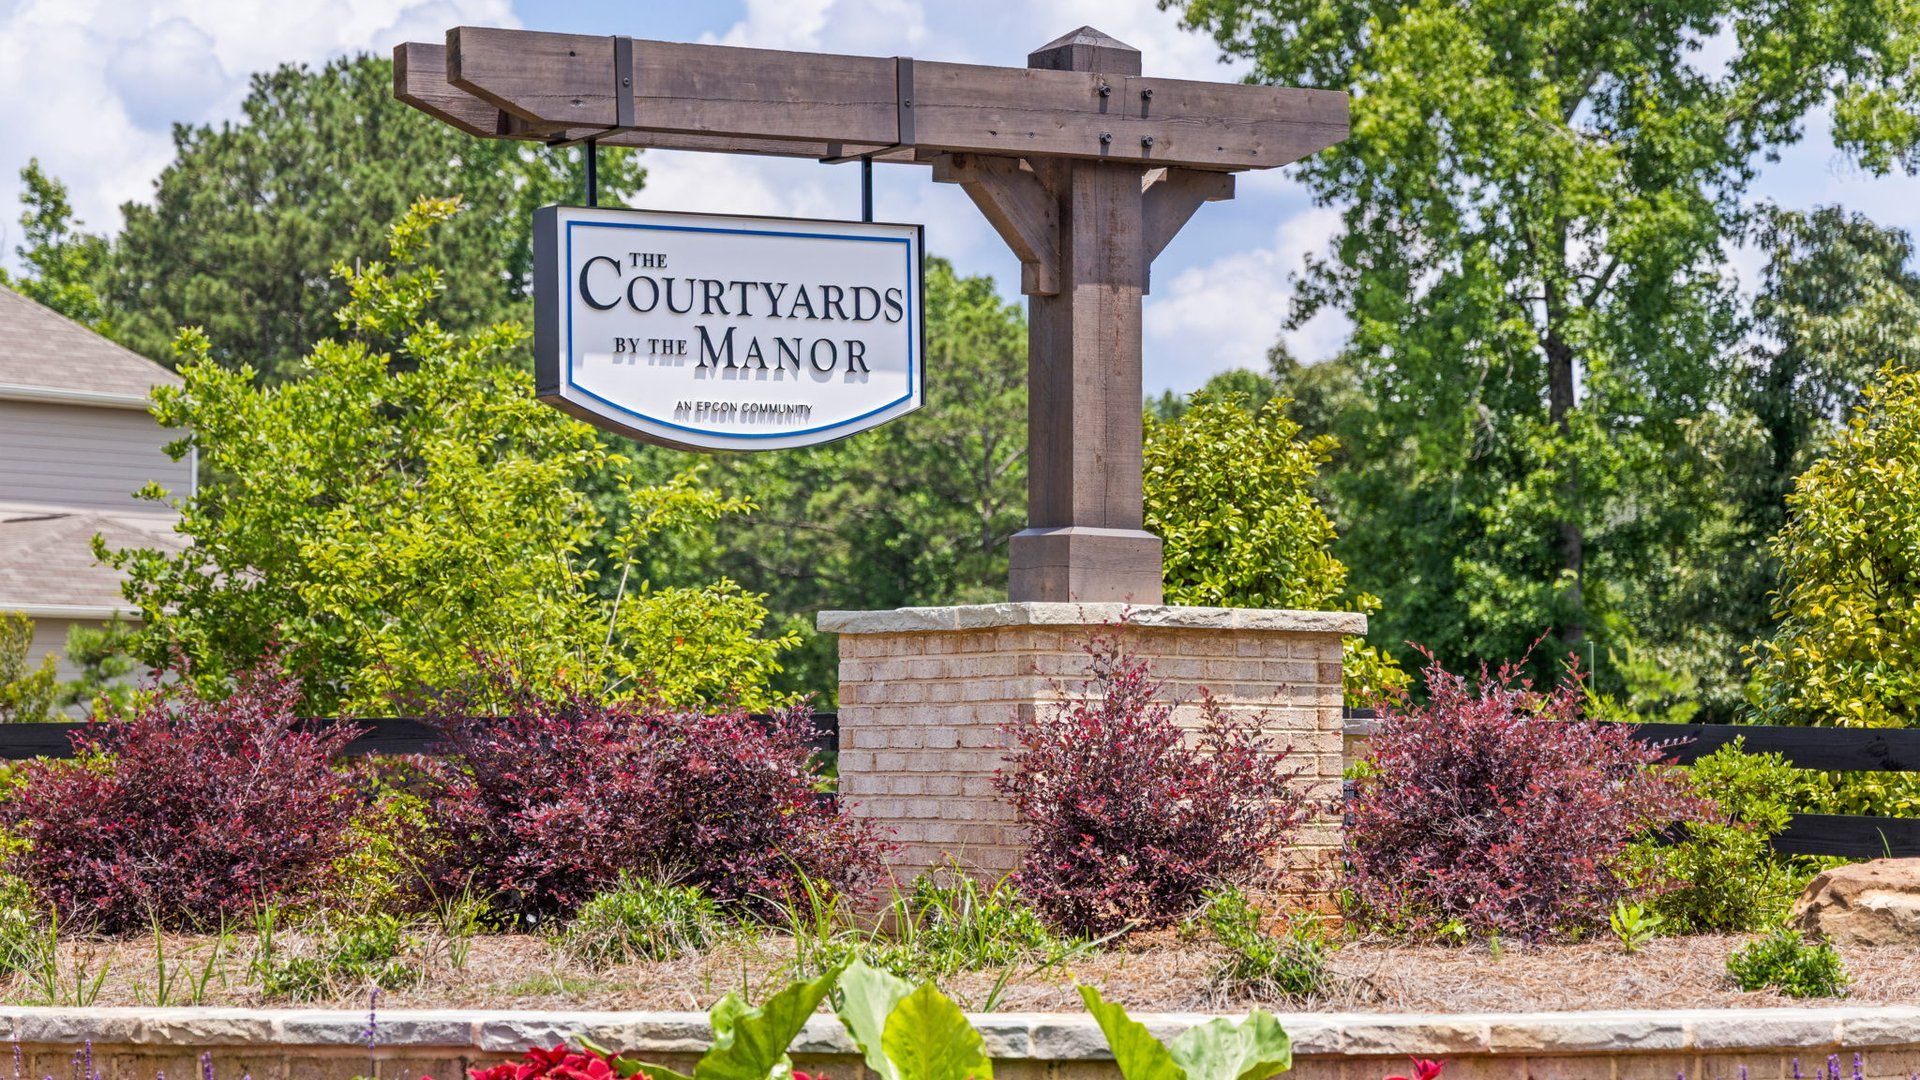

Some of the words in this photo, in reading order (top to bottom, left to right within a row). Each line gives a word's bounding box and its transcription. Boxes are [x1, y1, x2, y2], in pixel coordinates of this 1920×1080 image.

[629, 252, 667, 269] THE
[579, 256, 903, 323] COURTYARDS
[614, 337, 640, 353] BY
[648, 338, 687, 355] THE
[695, 325, 870, 373] MANOR
[676, 401, 692, 411] AN
[697, 401, 737, 412] EPCON
[742, 402, 812, 414] COMMUNITY
